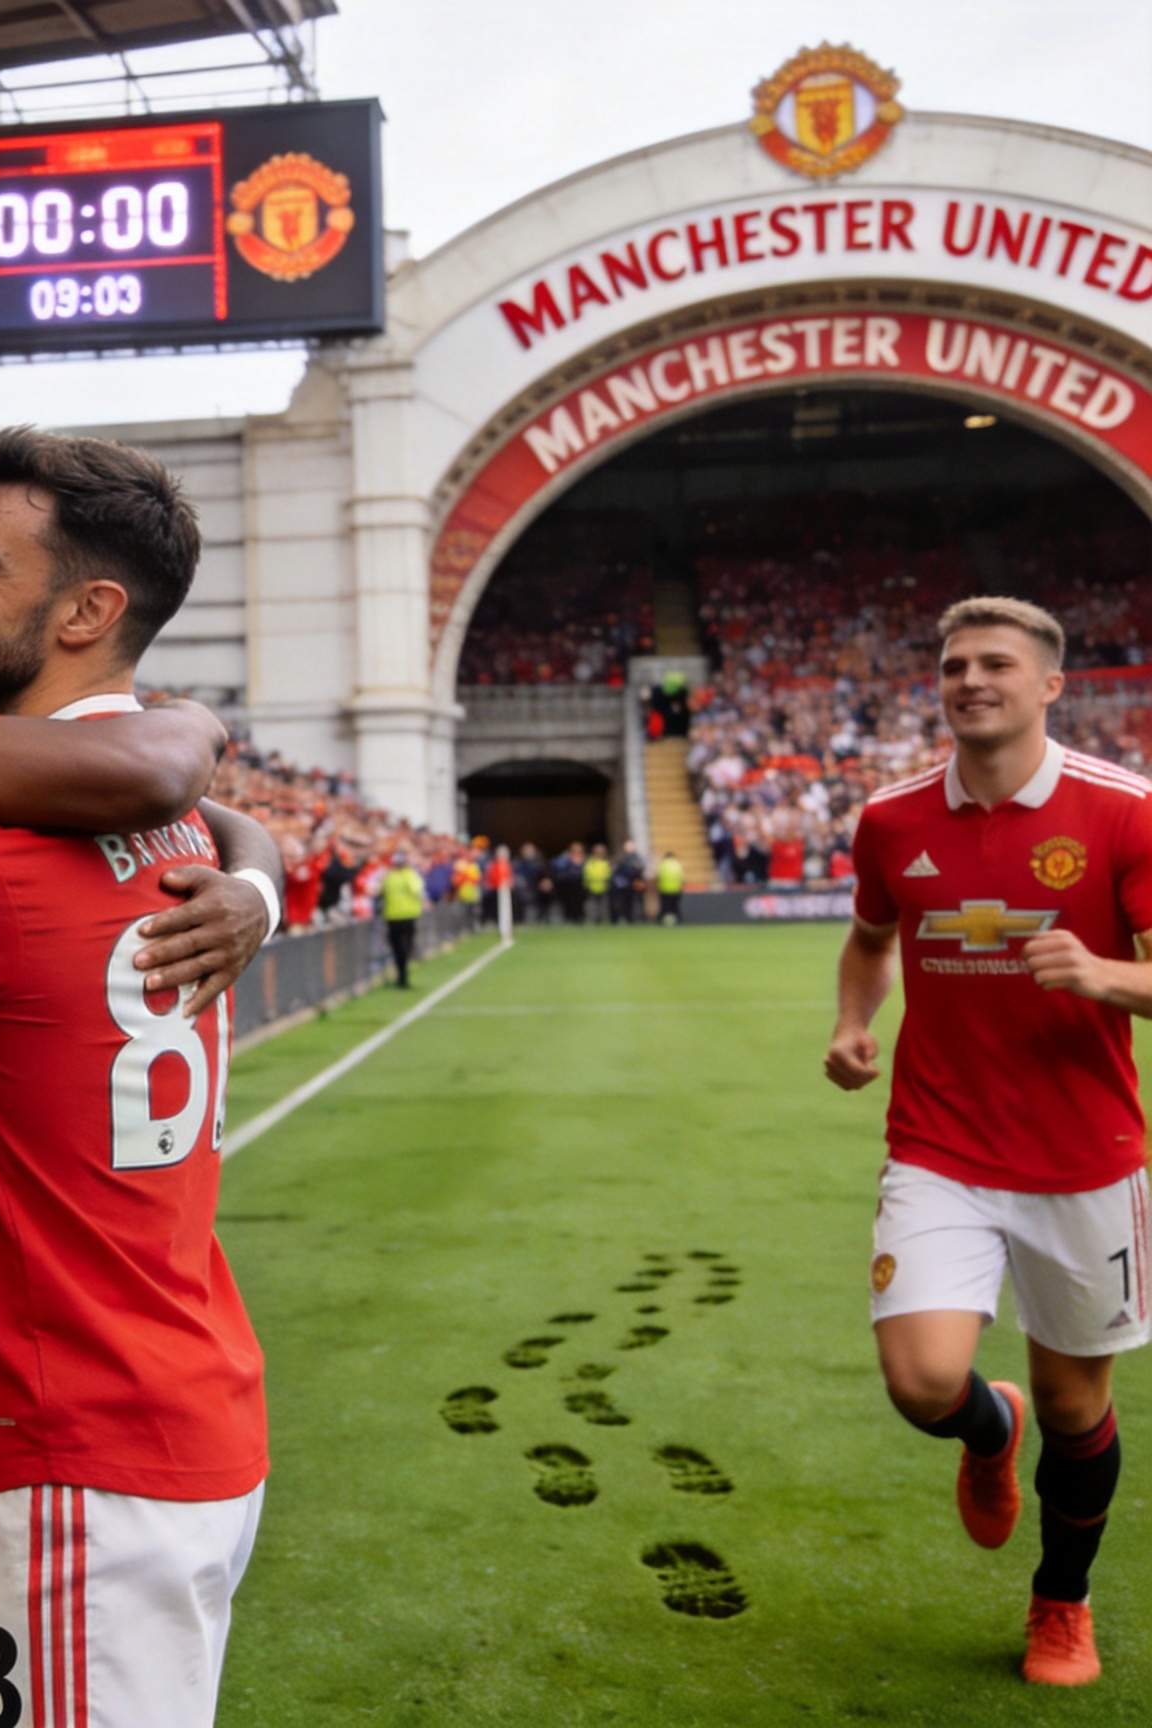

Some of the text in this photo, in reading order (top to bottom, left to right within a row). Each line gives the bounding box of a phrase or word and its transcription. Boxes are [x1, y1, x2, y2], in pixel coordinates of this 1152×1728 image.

[30, 273, 142, 321] 09:03
[498, 200, 916, 350] MANCHESTER
[943, 201, 1152, 303] UNITED
[523, 317, 1135, 473] MANCHESTER UNITED
